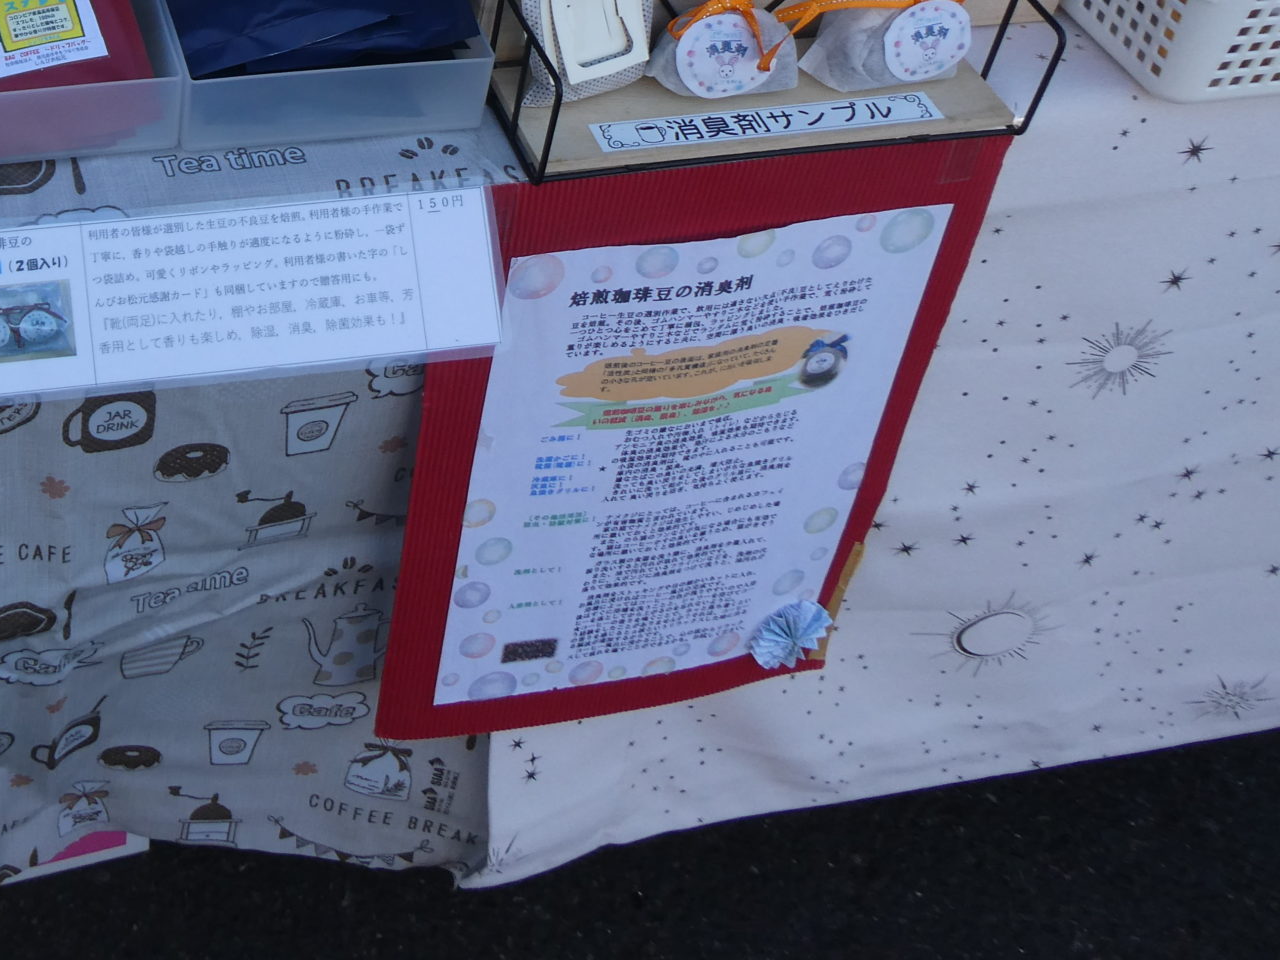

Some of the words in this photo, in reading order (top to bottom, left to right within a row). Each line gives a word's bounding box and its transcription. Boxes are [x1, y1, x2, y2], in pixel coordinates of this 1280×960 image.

[667, 100, 893, 141] 消臭剤サンプル
[154, 151, 221, 178] Tea
[224, 143, 306, 173] time
[568, 274, 754, 308] 焙煎珈琲豆の消臭剤
[96, 419, 139, 434] DRINK
[104, 409, 132, 423] JAR
[18, 544, 72, 564] CAFE
[308, 793, 394, 826] COFFEE
[407, 816, 479, 846] BREAK
